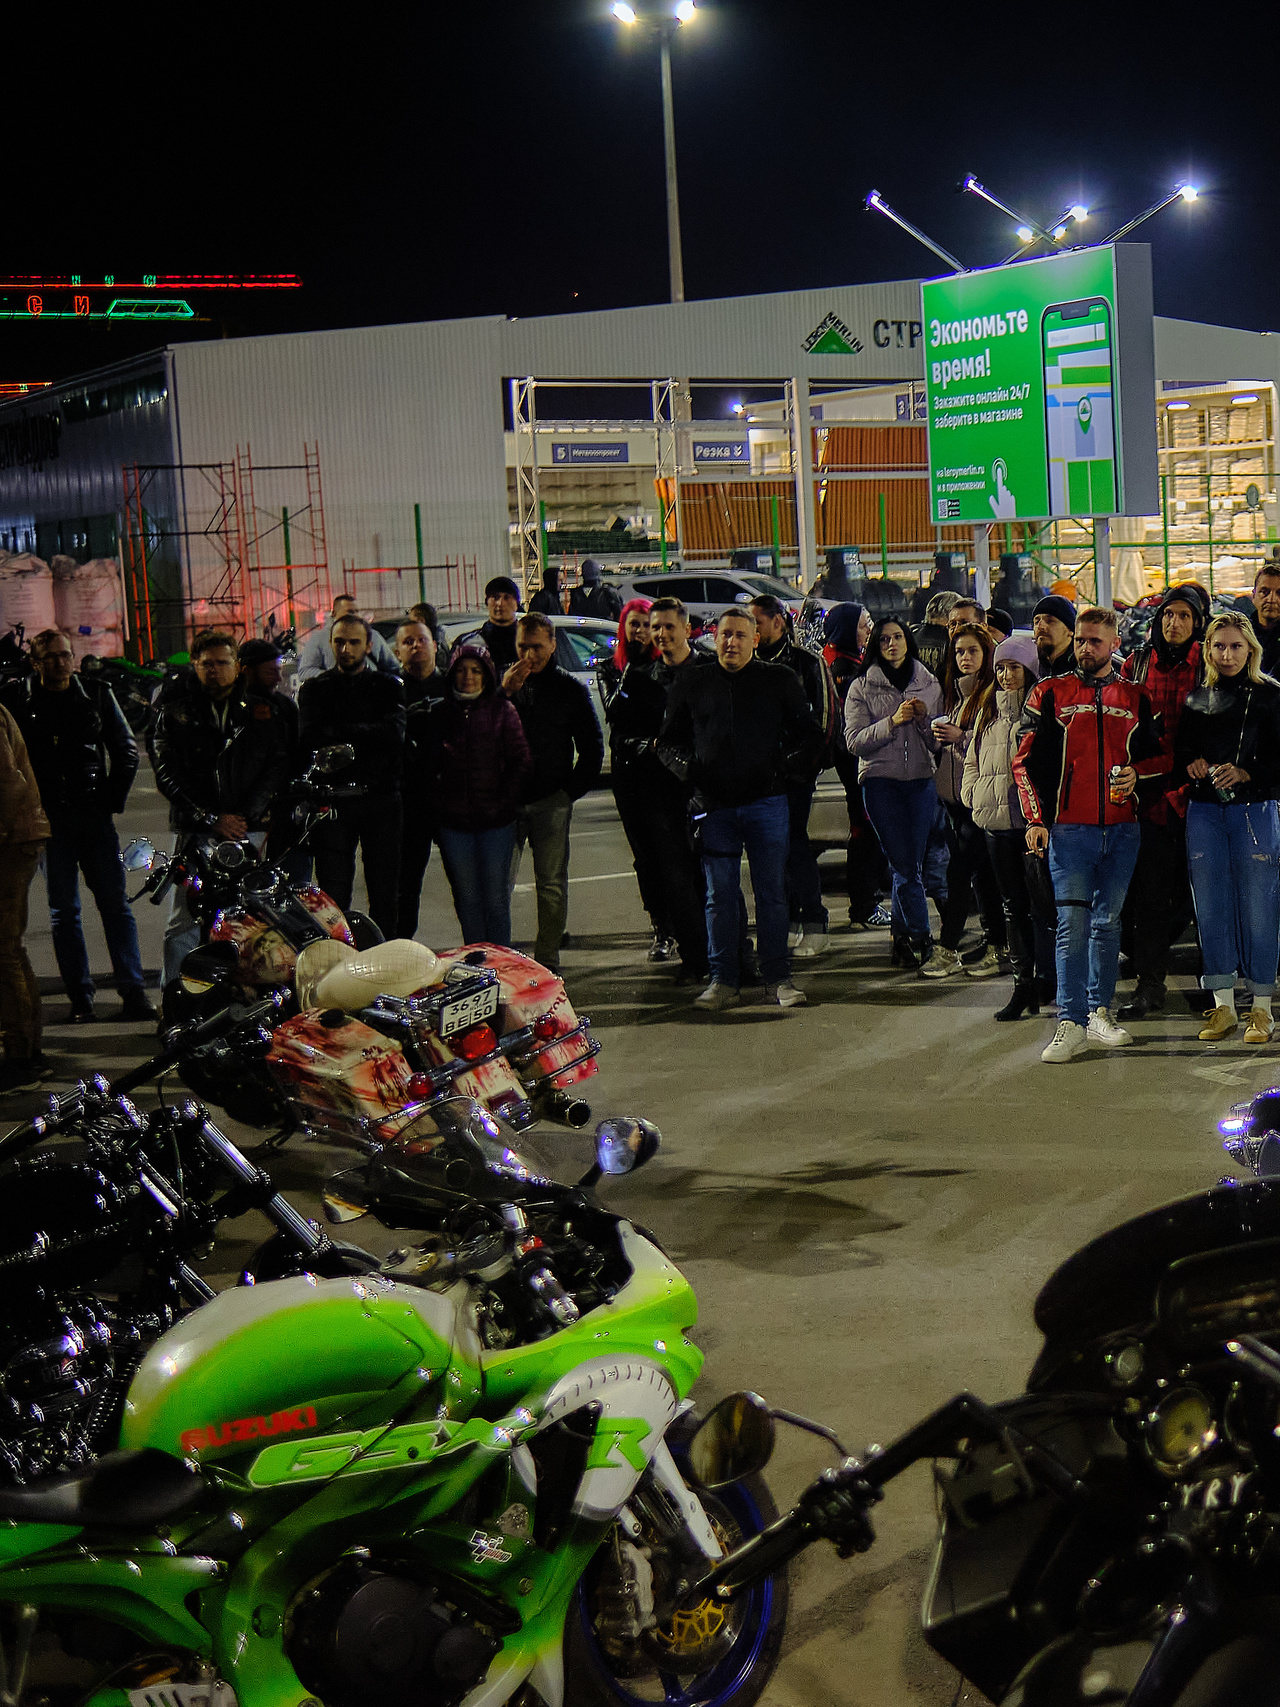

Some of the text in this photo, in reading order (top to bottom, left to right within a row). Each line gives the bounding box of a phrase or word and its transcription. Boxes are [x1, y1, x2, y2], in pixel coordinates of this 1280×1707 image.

[824, 311, 864, 354] MERLIN
[930, 309, 1029, 348] Экономьте
[932, 348, 991, 390] время!
[934, 383, 1031, 410] Закажите онлайн 24/7
[935, 407, 1024, 430] заберите в магазине
[557, 446, 567, 460] 5
[695, 445, 731, 458] Резка
[944, 464, 985, 479] leroymerlin.ru
[946, 481, 986, 494] приложении
[450, 989, 491, 1015] 3697
[445, 1005, 492, 1034] ВЕ 50
[179, 1405, 318, 1454] SUZUKI
